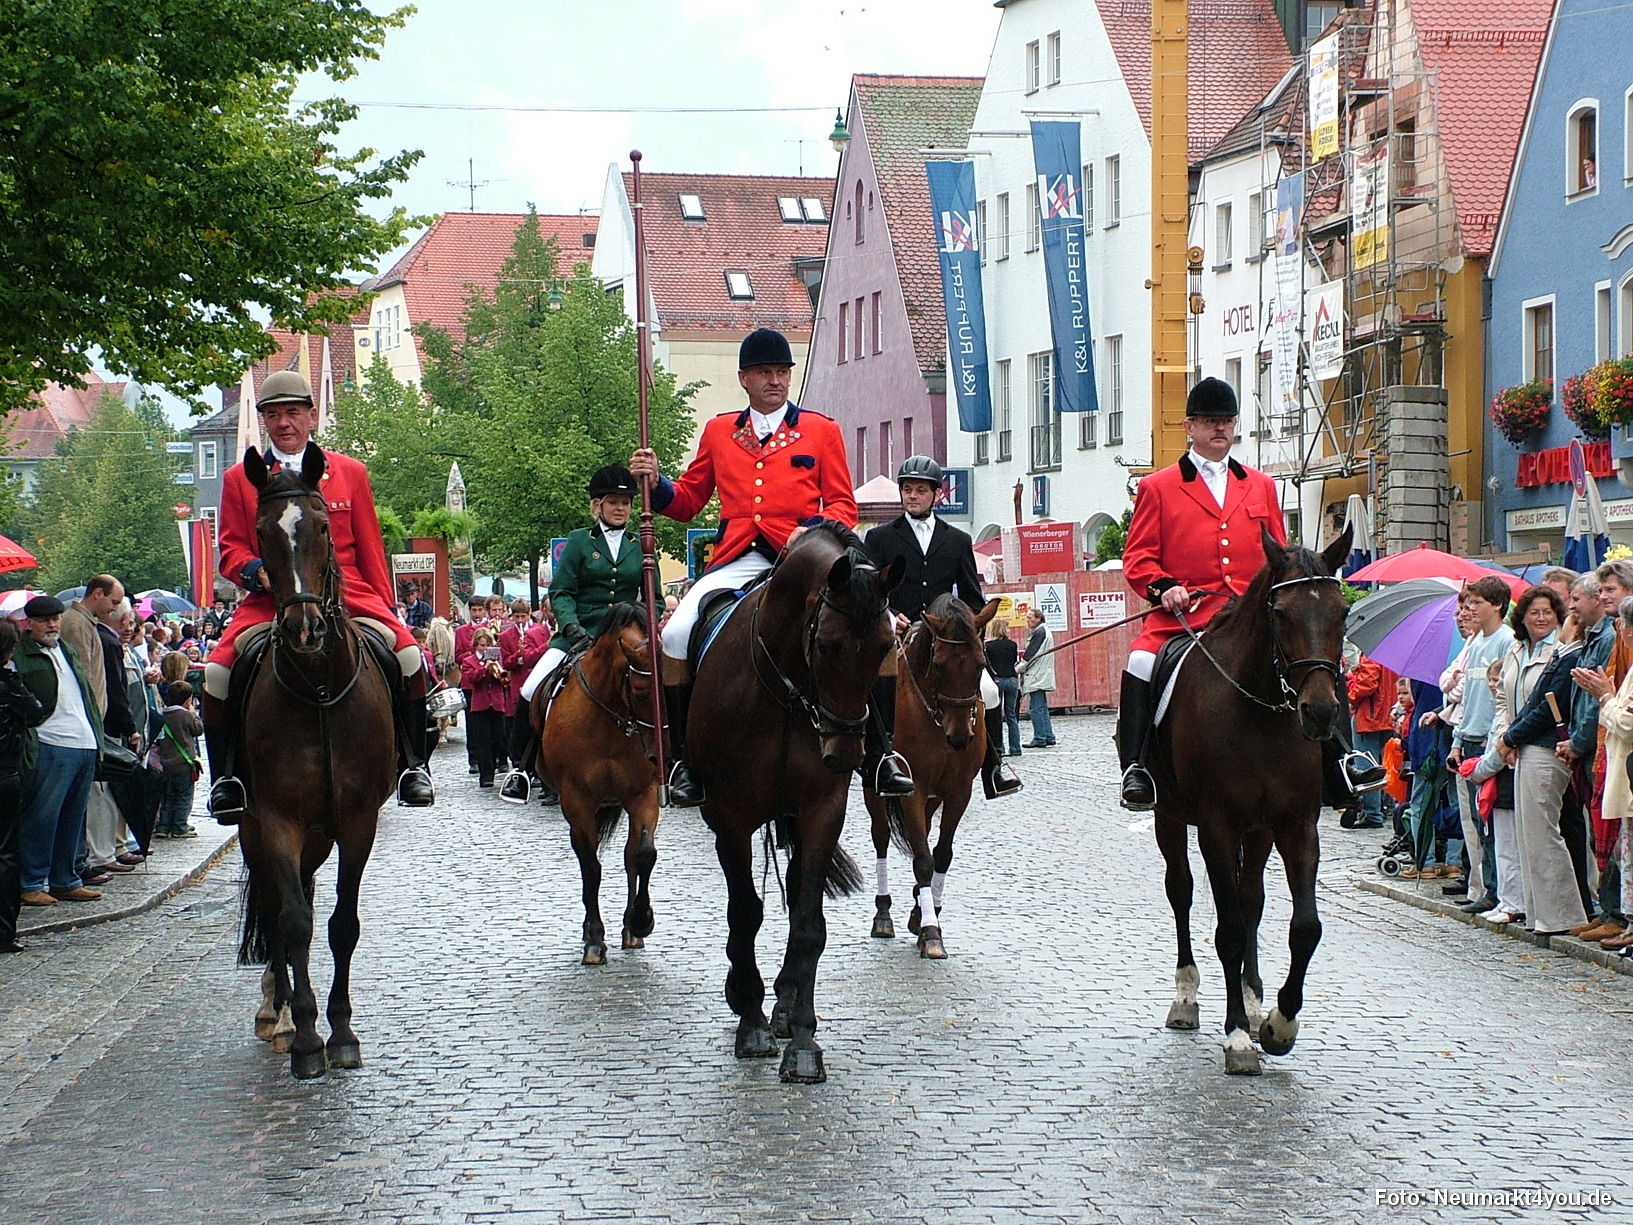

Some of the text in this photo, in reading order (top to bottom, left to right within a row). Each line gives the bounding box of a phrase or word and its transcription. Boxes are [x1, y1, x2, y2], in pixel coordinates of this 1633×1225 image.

[1066, 228, 1088, 374] K&L RUPPERT
[1223, 304, 1255, 336] HOTEL
[1314, 321, 1340, 341] KECKL
[1515, 441, 1618, 489] APOTHKE
[1515, 511, 1559, 526] RATHAUS APOTHEKE
[1022, 530, 1069, 538] Wienerberger
[393, 558, 419, 570] Neumarkt
[1081, 594, 1124, 602] FRUTH
[1041, 604, 1062, 613] PEA
[1467, 667, 1488, 680] PUM
